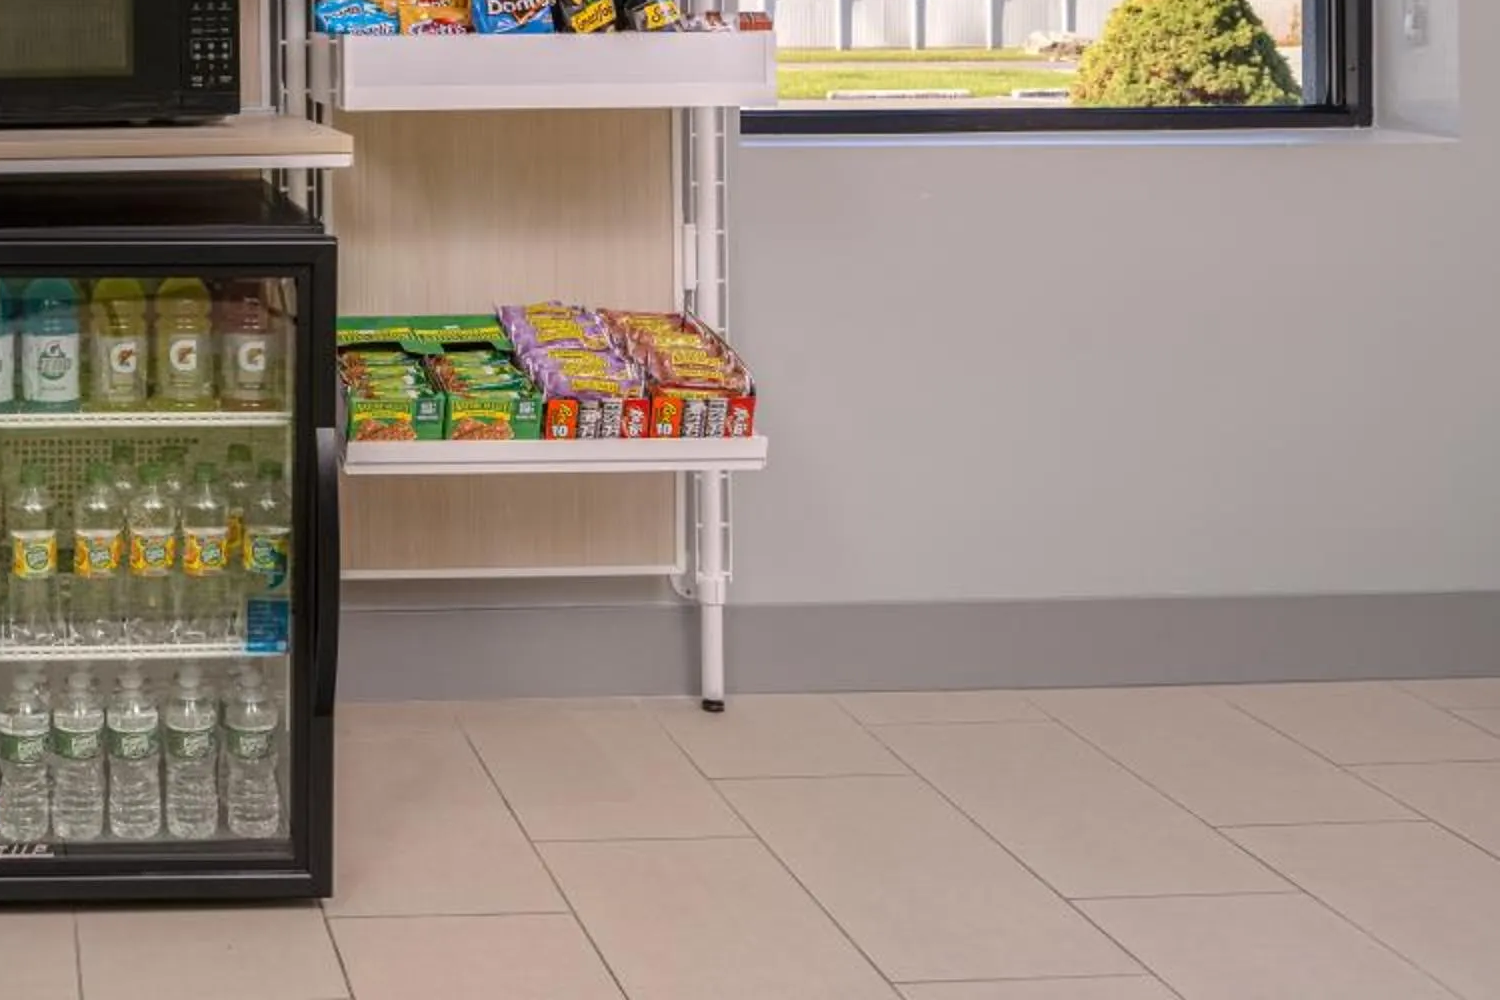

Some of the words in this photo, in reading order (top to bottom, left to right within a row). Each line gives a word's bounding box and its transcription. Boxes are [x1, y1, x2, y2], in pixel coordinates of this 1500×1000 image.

[110, 342, 137, 373] G
[169, 340, 197, 372] G
[237, 341, 266, 372] G
